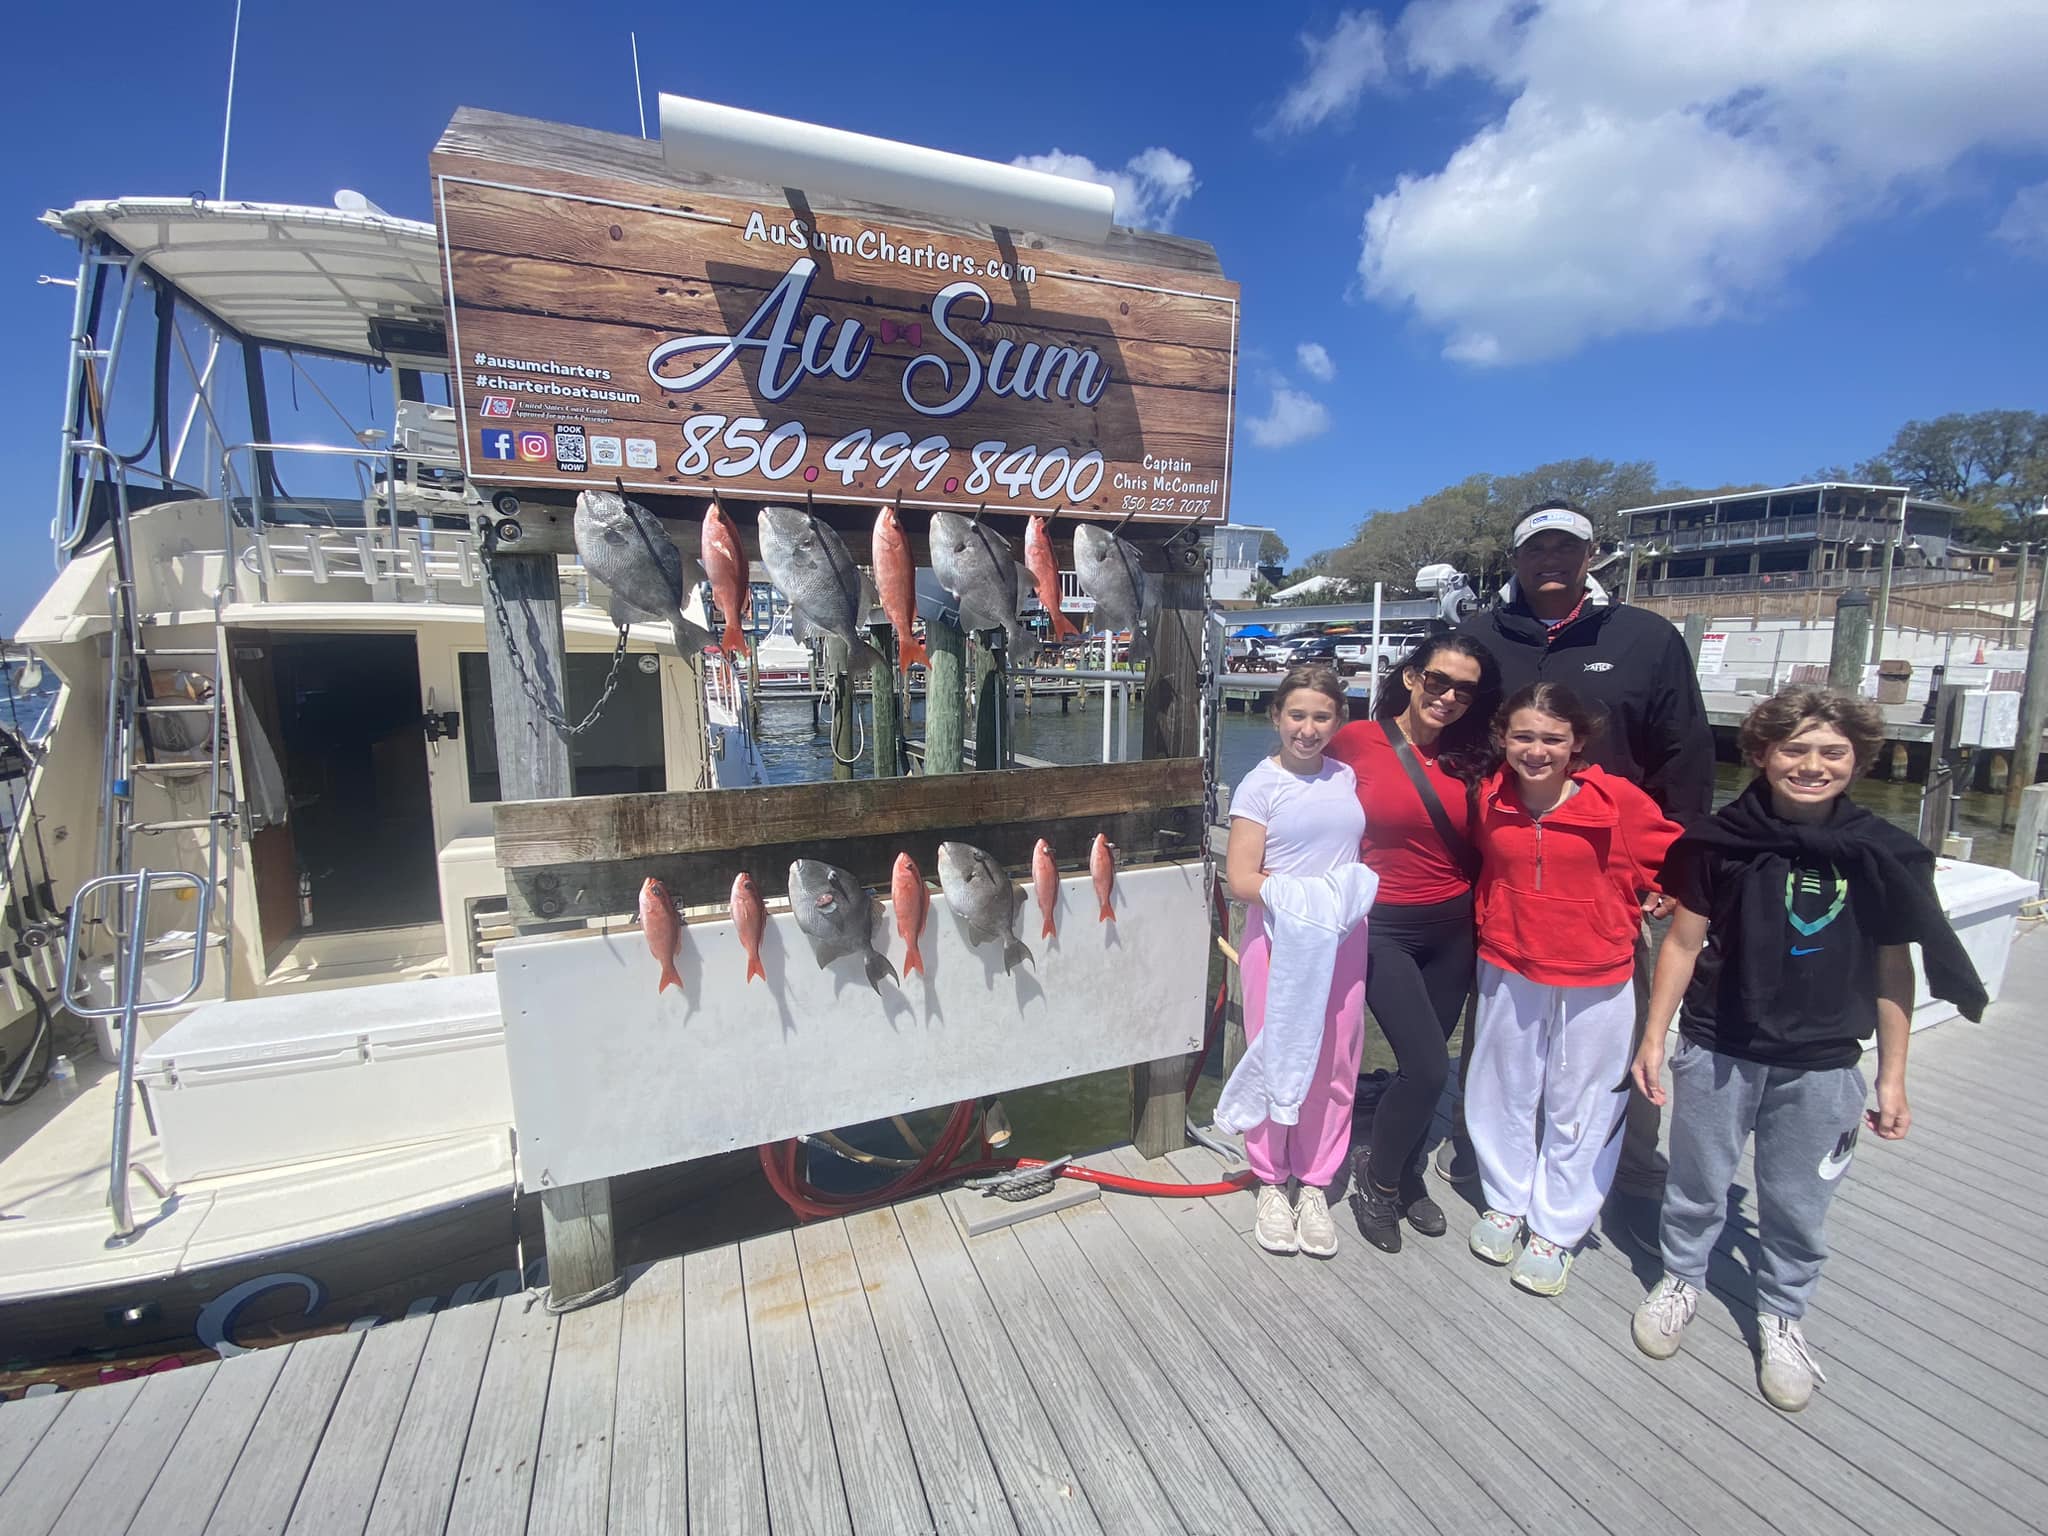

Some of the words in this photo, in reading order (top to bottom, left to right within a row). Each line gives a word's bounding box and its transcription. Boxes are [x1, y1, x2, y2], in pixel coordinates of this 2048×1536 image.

[743, 211, 1036, 283] AuSumCharters.com
[647, 256, 873, 402] Au
[901, 281, 1111, 417] Sum
[474, 352, 612, 381] #ausumcharters
[475, 374, 641, 404] #charterboatausum
[515, 410, 545, 419] Approved
[545, 412, 556, 420] for
[580, 415, 614, 424] Passengers
[519, 401, 542, 409] United
[544, 403, 564, 411] States
[565, 405, 585, 413] Coast
[586, 407, 608, 415] Guard
[557, 425, 582, 434] BOOK
[560, 463, 585, 472] NOW!
[675, 414, 1104, 503] 850.499.8400
[1143, 454, 1191, 474] Captain
[1113, 473, 1148, 490] Chris
[1153, 476, 1218, 495] McConnell
[1122, 495, 1211, 513] 850.259.7078
